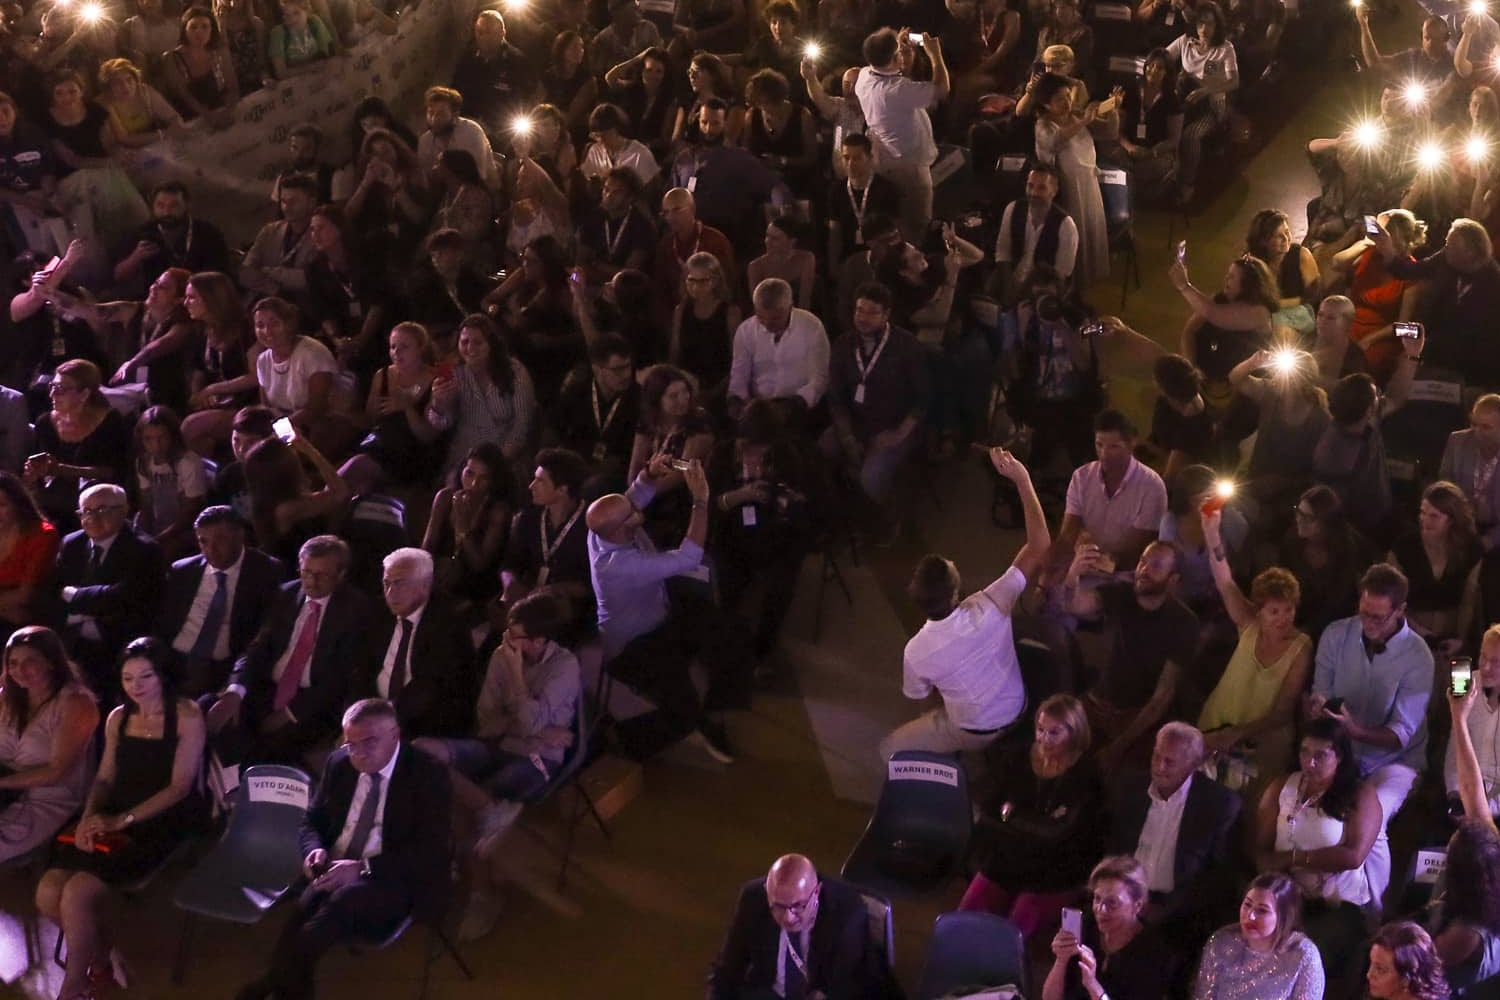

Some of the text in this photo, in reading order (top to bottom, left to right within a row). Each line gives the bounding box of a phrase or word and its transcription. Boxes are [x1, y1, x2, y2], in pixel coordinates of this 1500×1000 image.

[894, 766, 954, 779] WARNER BROS
[254, 781, 276, 789] VITO
